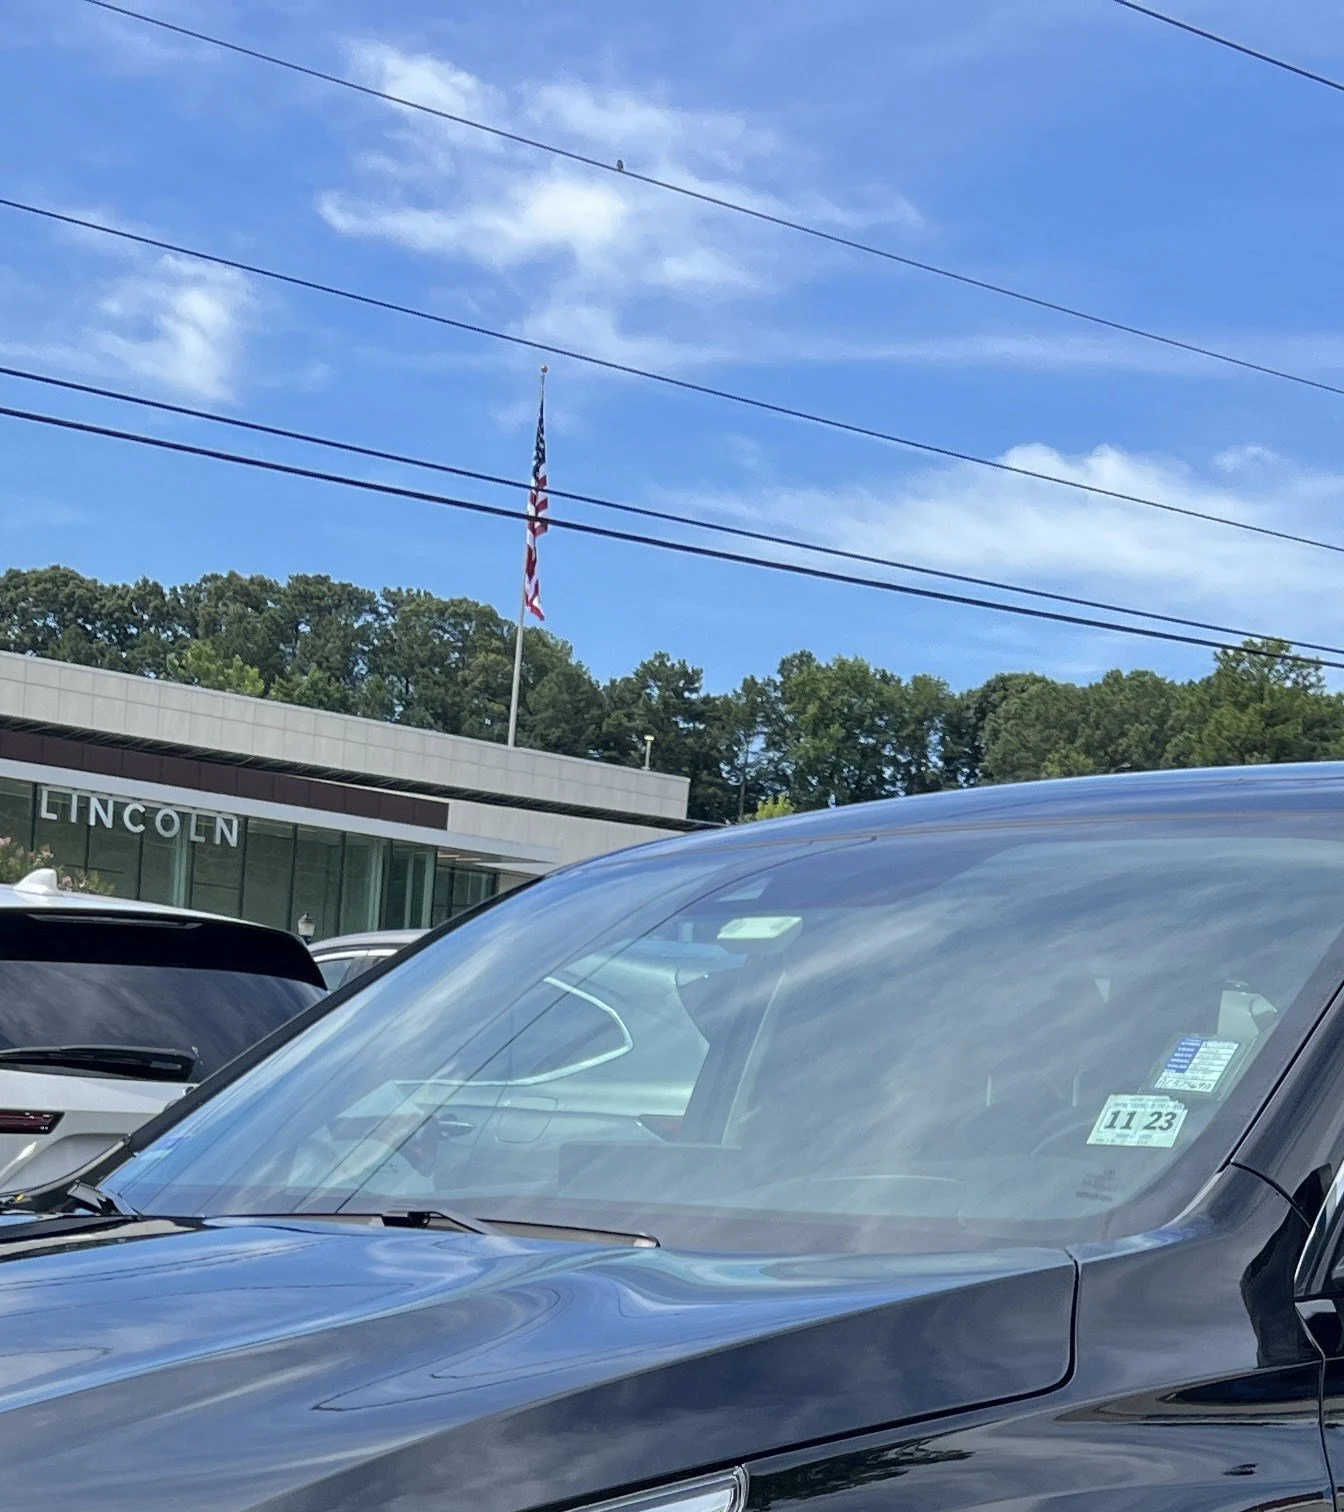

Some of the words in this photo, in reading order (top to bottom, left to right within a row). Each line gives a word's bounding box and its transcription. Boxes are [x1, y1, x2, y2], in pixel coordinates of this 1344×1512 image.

[40, 785, 239, 847] LINCOLN
[1104, 1110, 1137, 1130] 11
[1143, 1111, 1177, 1131] 23
